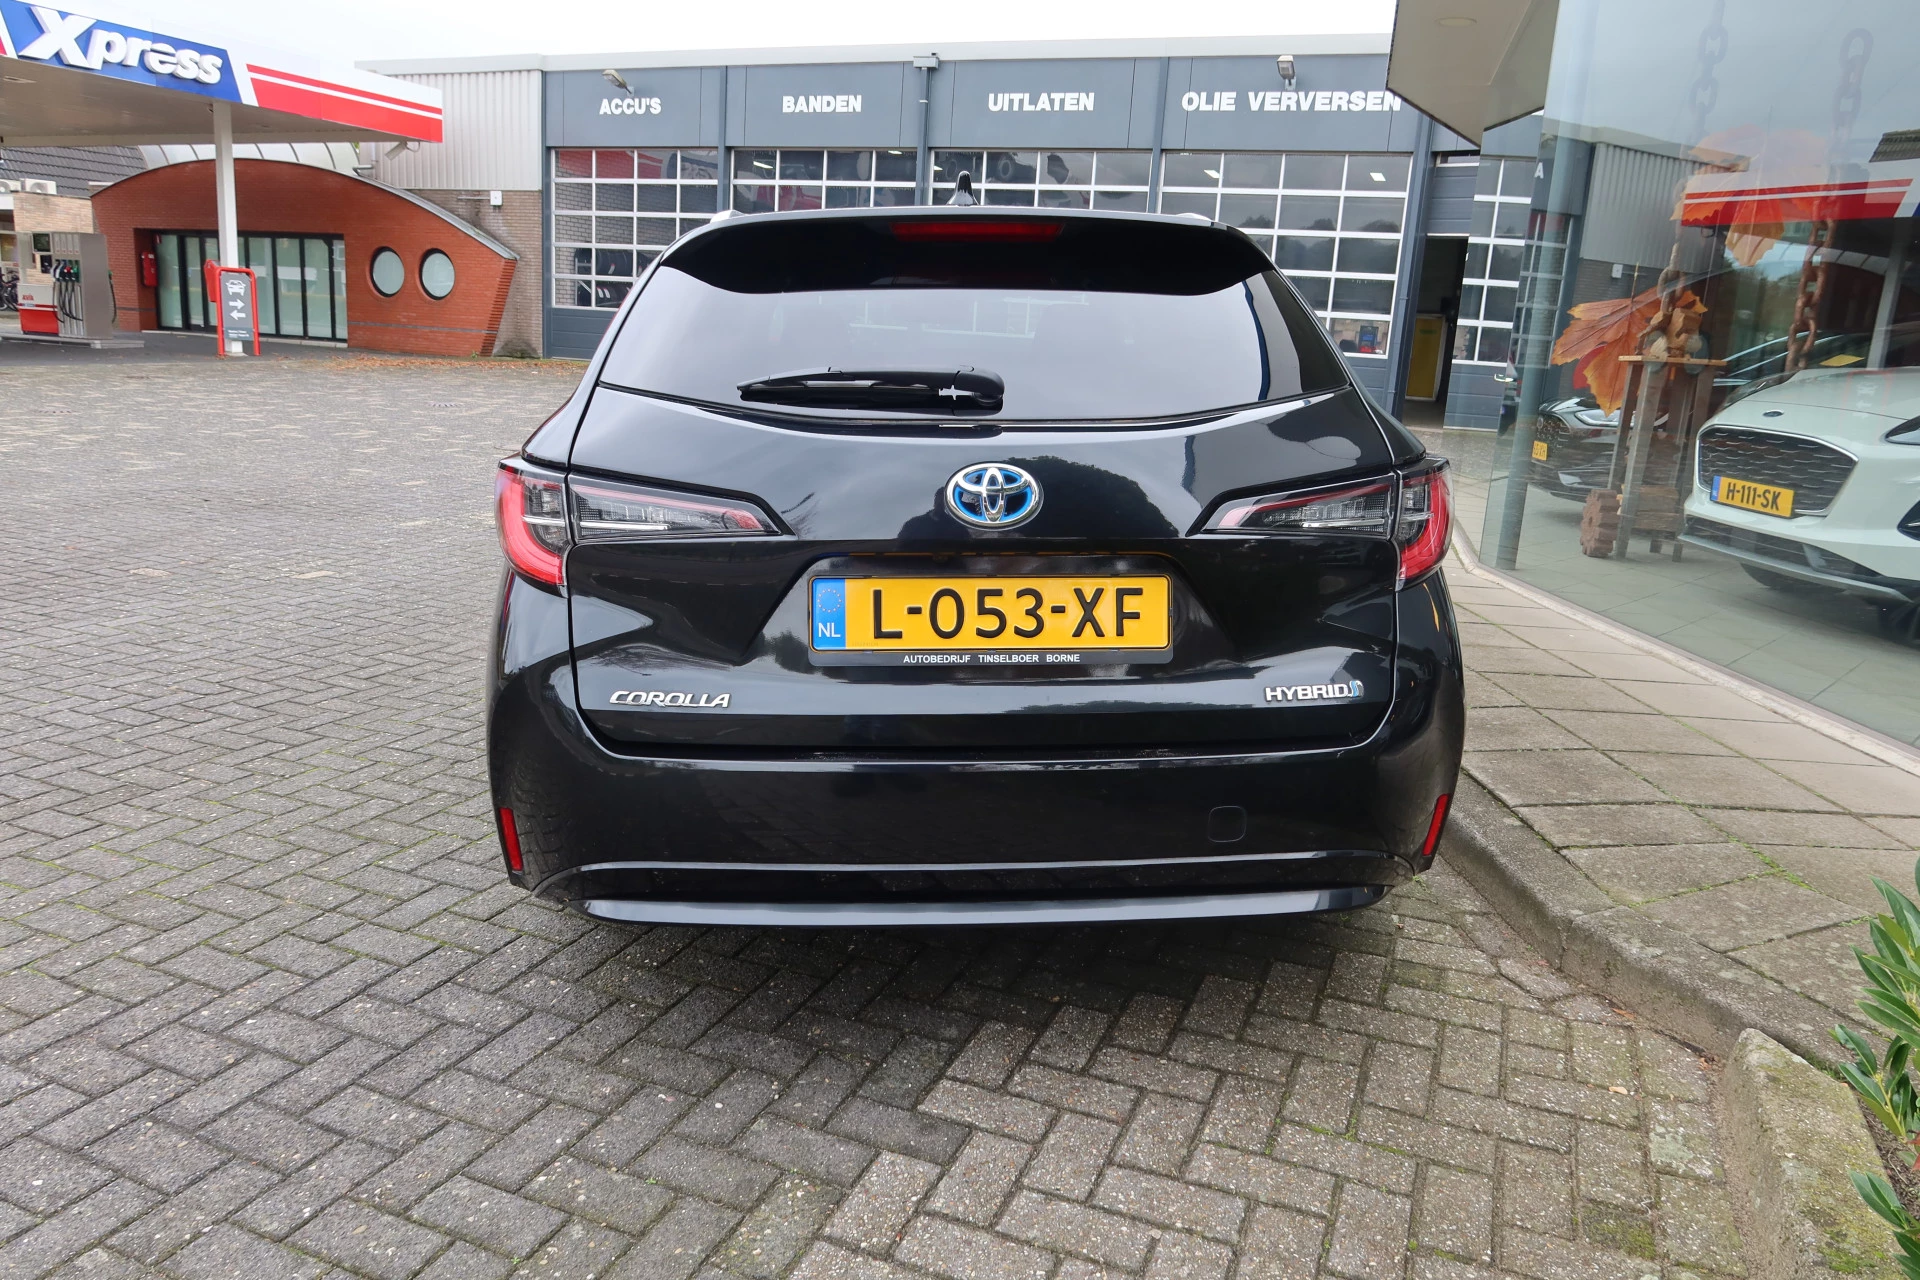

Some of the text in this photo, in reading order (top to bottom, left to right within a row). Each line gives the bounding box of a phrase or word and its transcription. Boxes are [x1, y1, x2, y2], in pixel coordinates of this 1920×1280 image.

[17, 6, 223, 84] Xpress
[599, 97, 662, 115] ACCU'S
[782, 95, 862, 113] BANDEN
[988, 92, 1095, 112] UITLATEN
[1181, 90, 1402, 112] OLIE VERVERSEN
[1726, 482, 1781, 511] H-111-SK
[873, 587, 1144, 639] L-053-XF
[818, 622, 841, 638] NL
[903, 654, 1080, 664] AUTOBEDRIJF TINSELBOER BORNE
[609, 690, 731, 708] COROLLA
[1265, 683, 1349, 702] HYBRID
